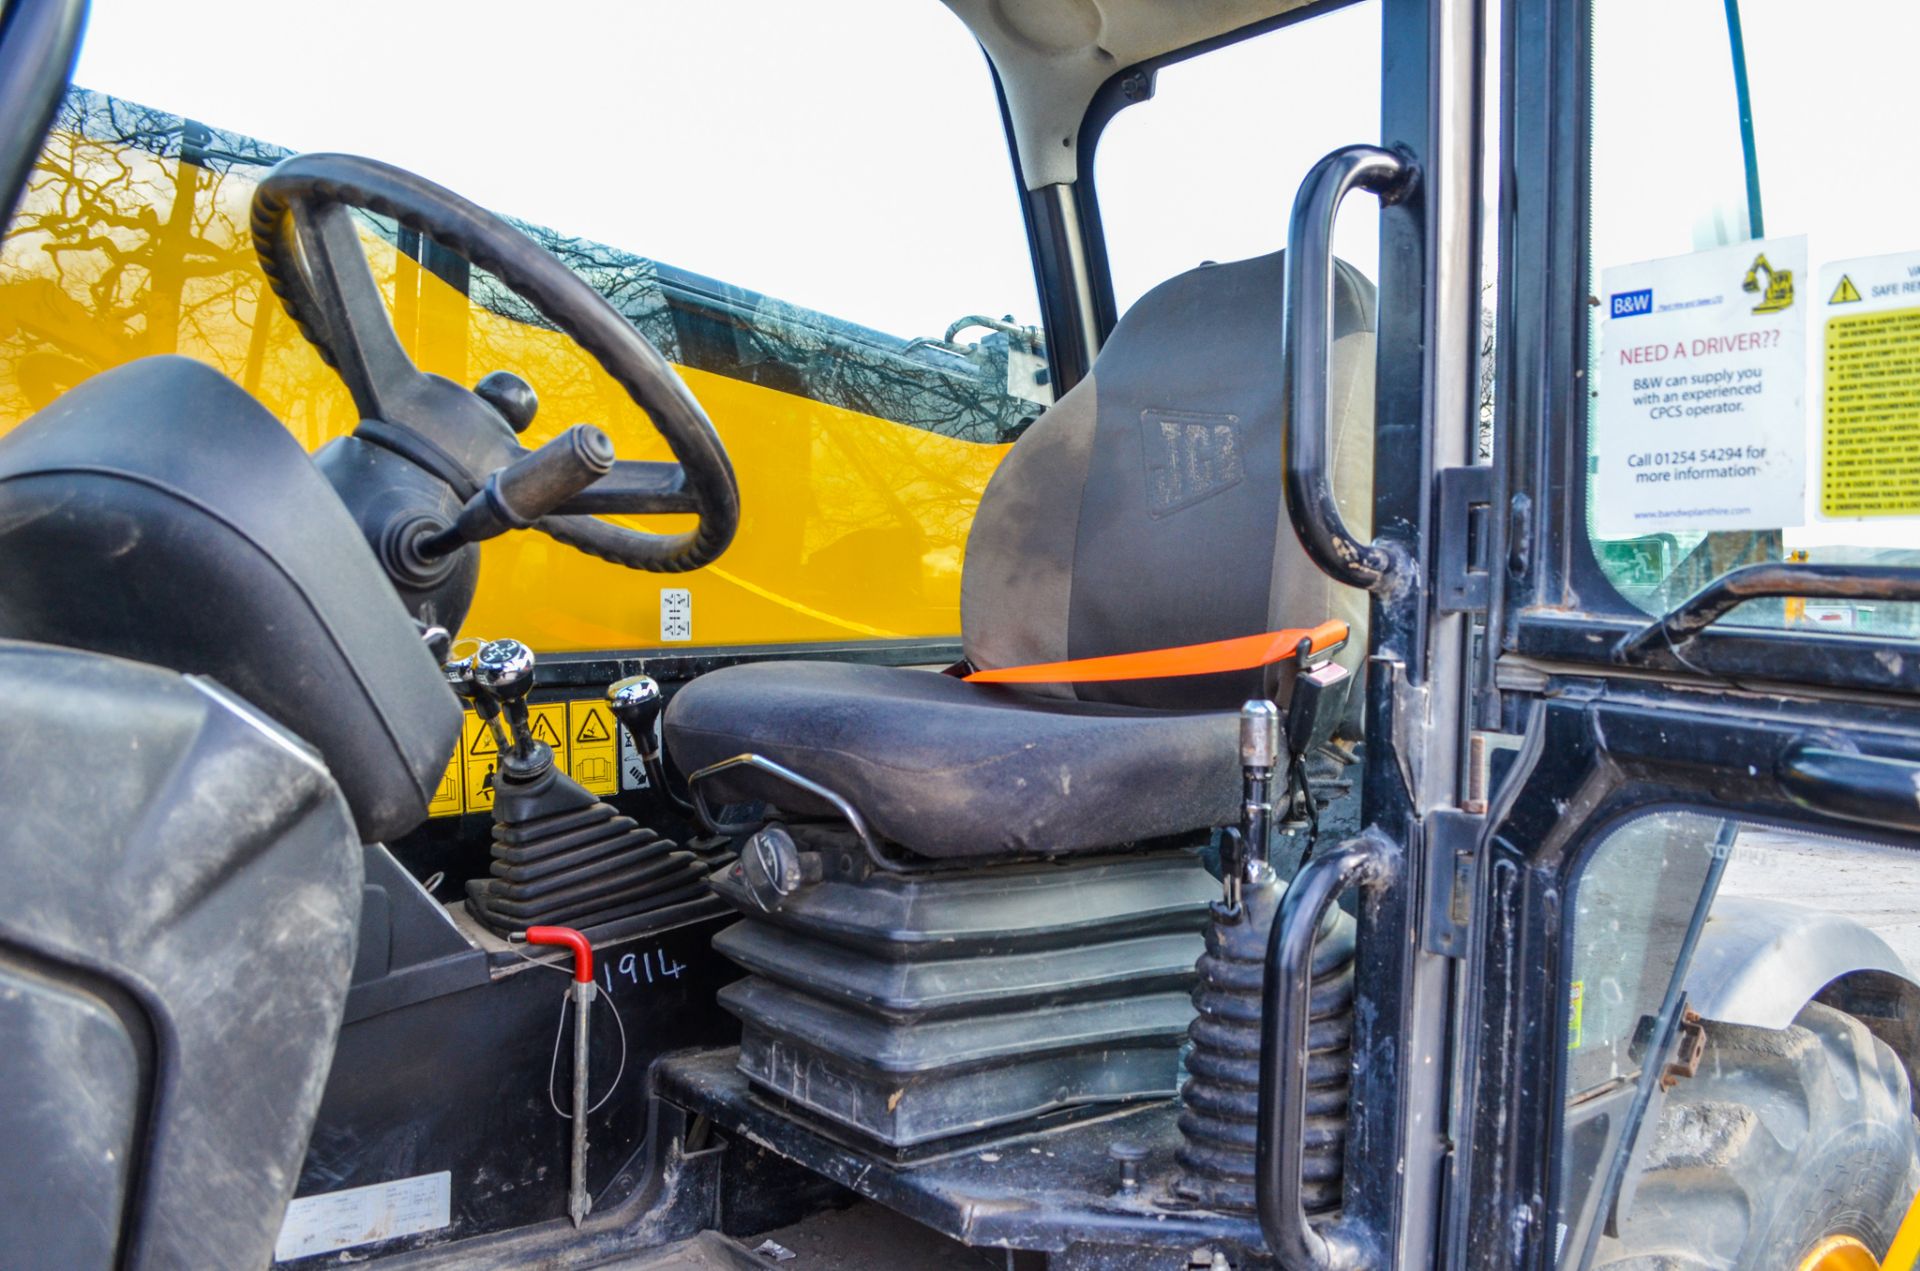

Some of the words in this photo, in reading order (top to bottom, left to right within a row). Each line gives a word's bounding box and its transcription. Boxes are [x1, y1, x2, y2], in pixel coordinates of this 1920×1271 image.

[1871, 283, 1899, 298] SAFE
[1613, 294, 1650, 315] B&W
[1619, 343, 1669, 366] NEED
[1673, 341, 1687, 359] A
[1692, 328, 1781, 357] DRIVER??
[1633, 376, 1663, 391] B&W
[1665, 374, 1687, 388] can
[1690, 369, 1733, 386] supply
[1736, 367, 1763, 383] you
[1632, 391, 1660, 406] with
[1662, 391, 1678, 403] an
[1681, 382, 1763, 405] experienced
[1649, 405, 1682, 420] CPCS
[1685, 401, 1745, 418] operator.
[1152, 419, 1237, 504] JCB
[1627, 453, 1652, 468] Call
[1655, 451, 1696, 466] 01254
[1700, 447, 1743, 462] 54294
[1746, 445, 1768, 460] for
[1636, 470, 1671, 483] more
[1674, 464, 1757, 481] information
[1634, 507, 1752, 520] www.bandwplanthire.com
[603, 948, 687, 993] 1914
